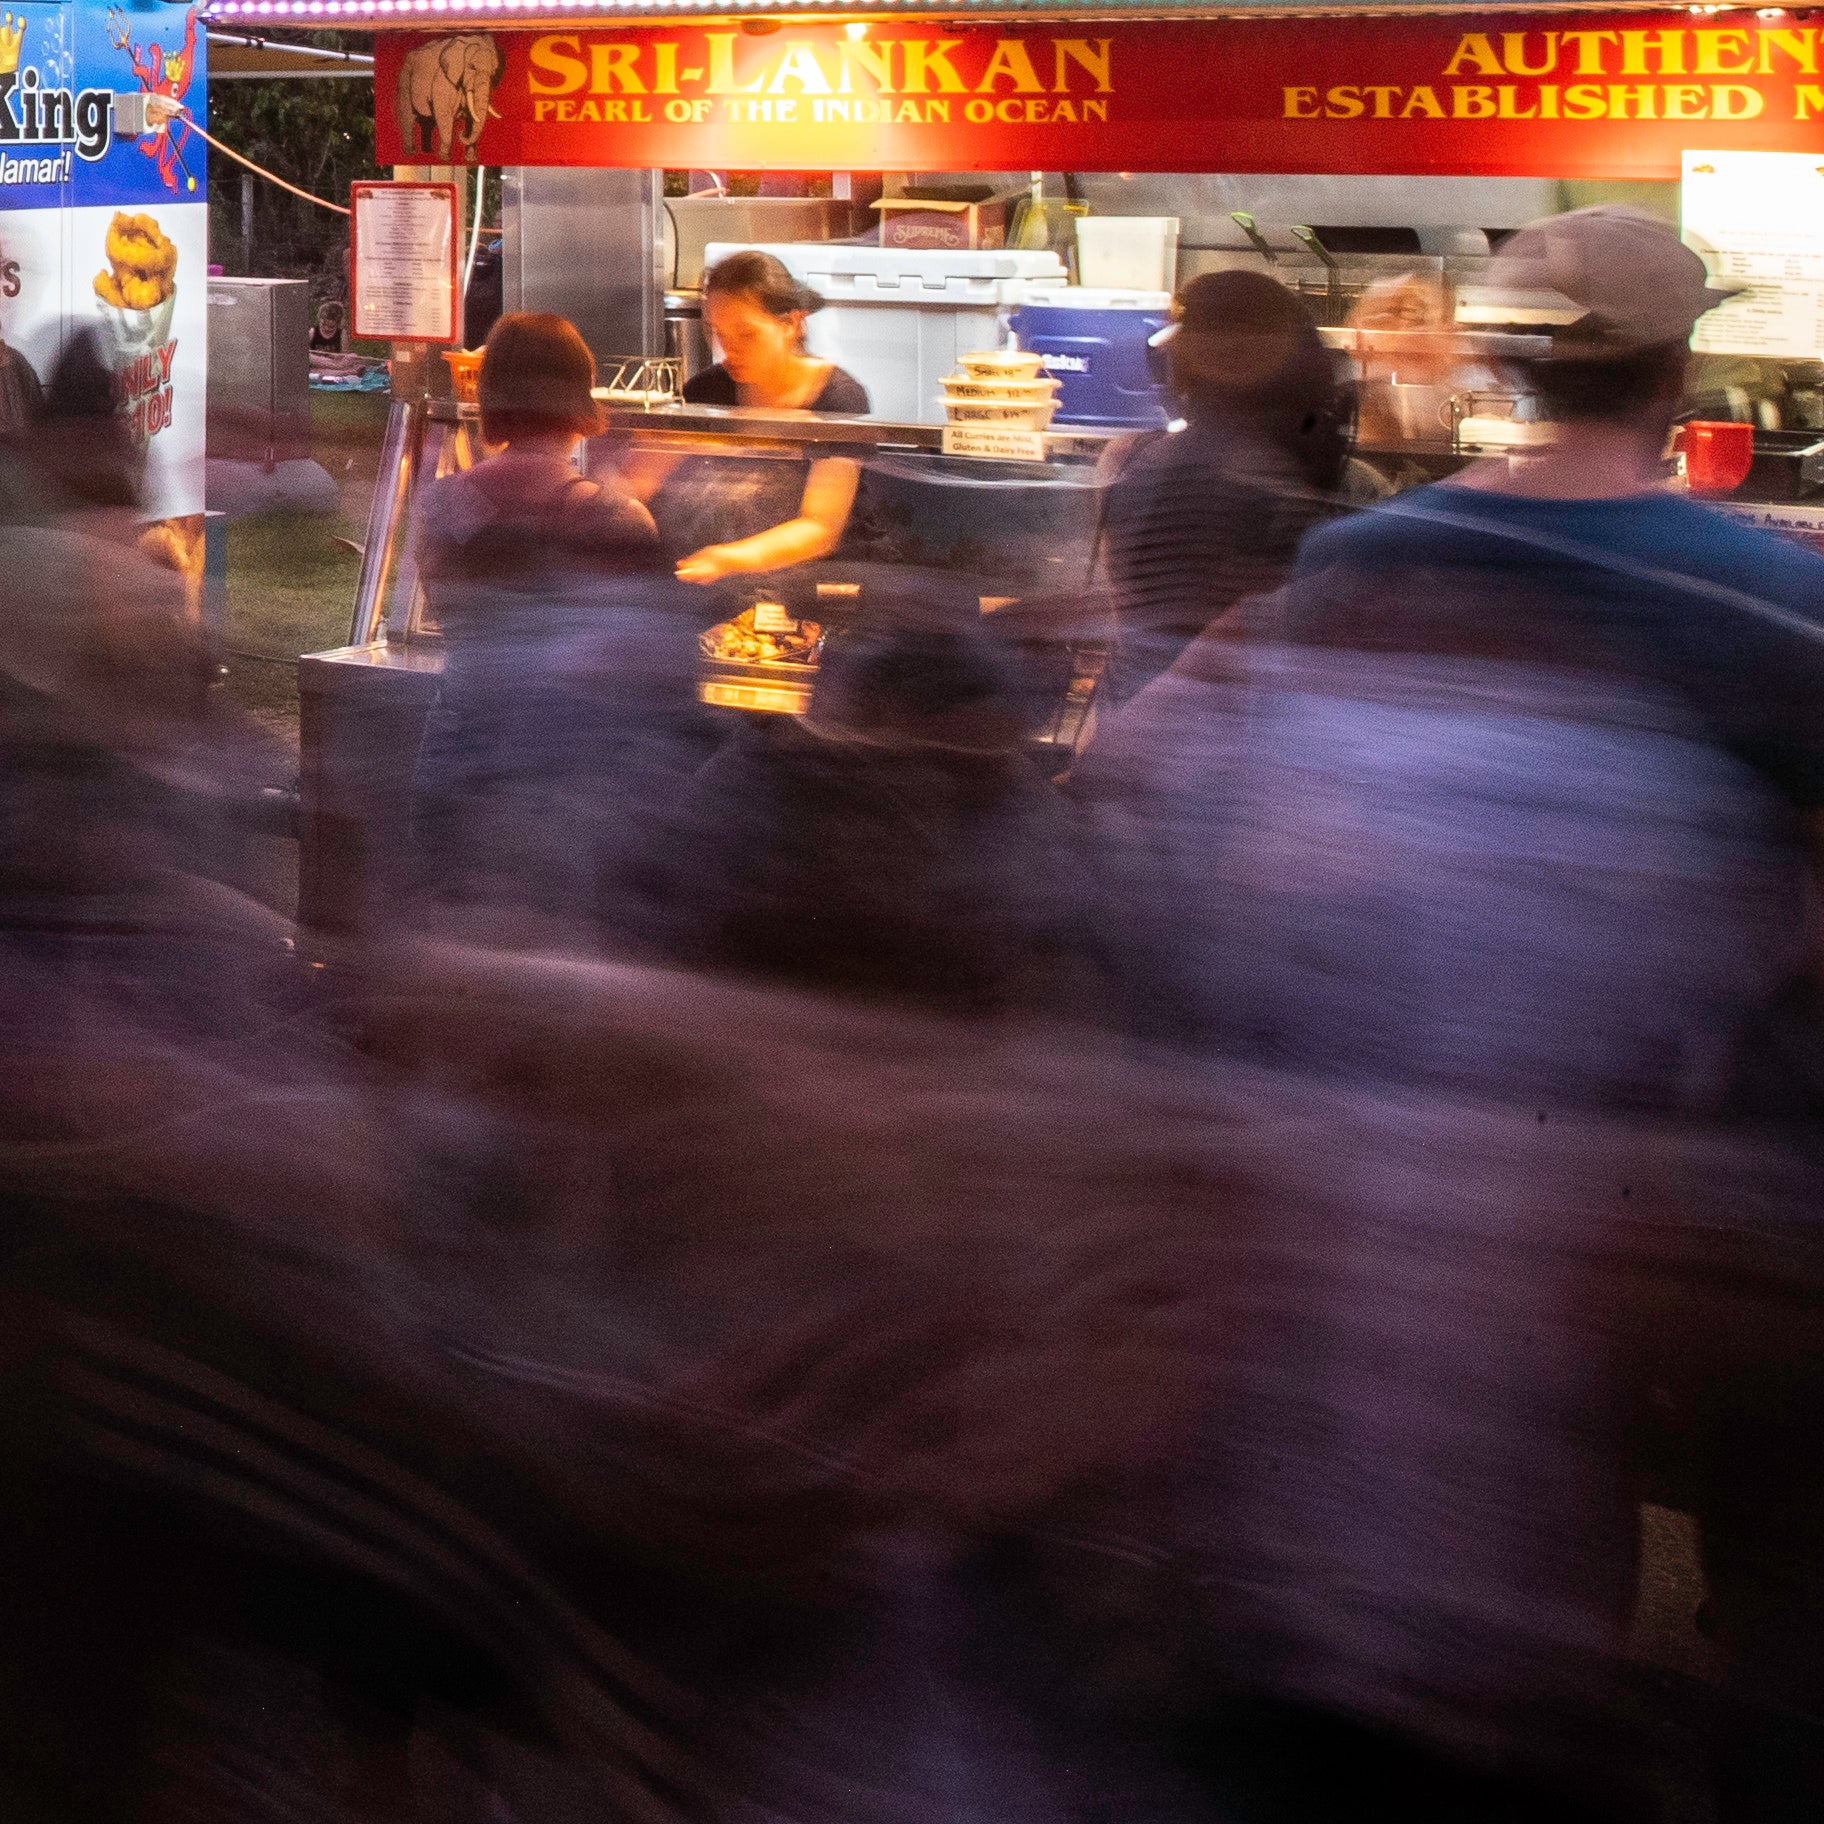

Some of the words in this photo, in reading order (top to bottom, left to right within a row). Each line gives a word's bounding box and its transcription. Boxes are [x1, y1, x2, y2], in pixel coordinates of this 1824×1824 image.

[527, 32, 1116, 95] SRI-LANKAN
[1440, 28, 1824, 76] AUTHEN
[534, 99, 652, 123] PEARL
[664, 98, 713, 123] OF
[724, 98, 799, 123] THE
[812, 98, 950, 123] INDIAN
[964, 98, 1108, 124] OCEAN
[1281, 84, 1764, 120] ESTABLISHED
[120, 338, 177, 405] NLY
